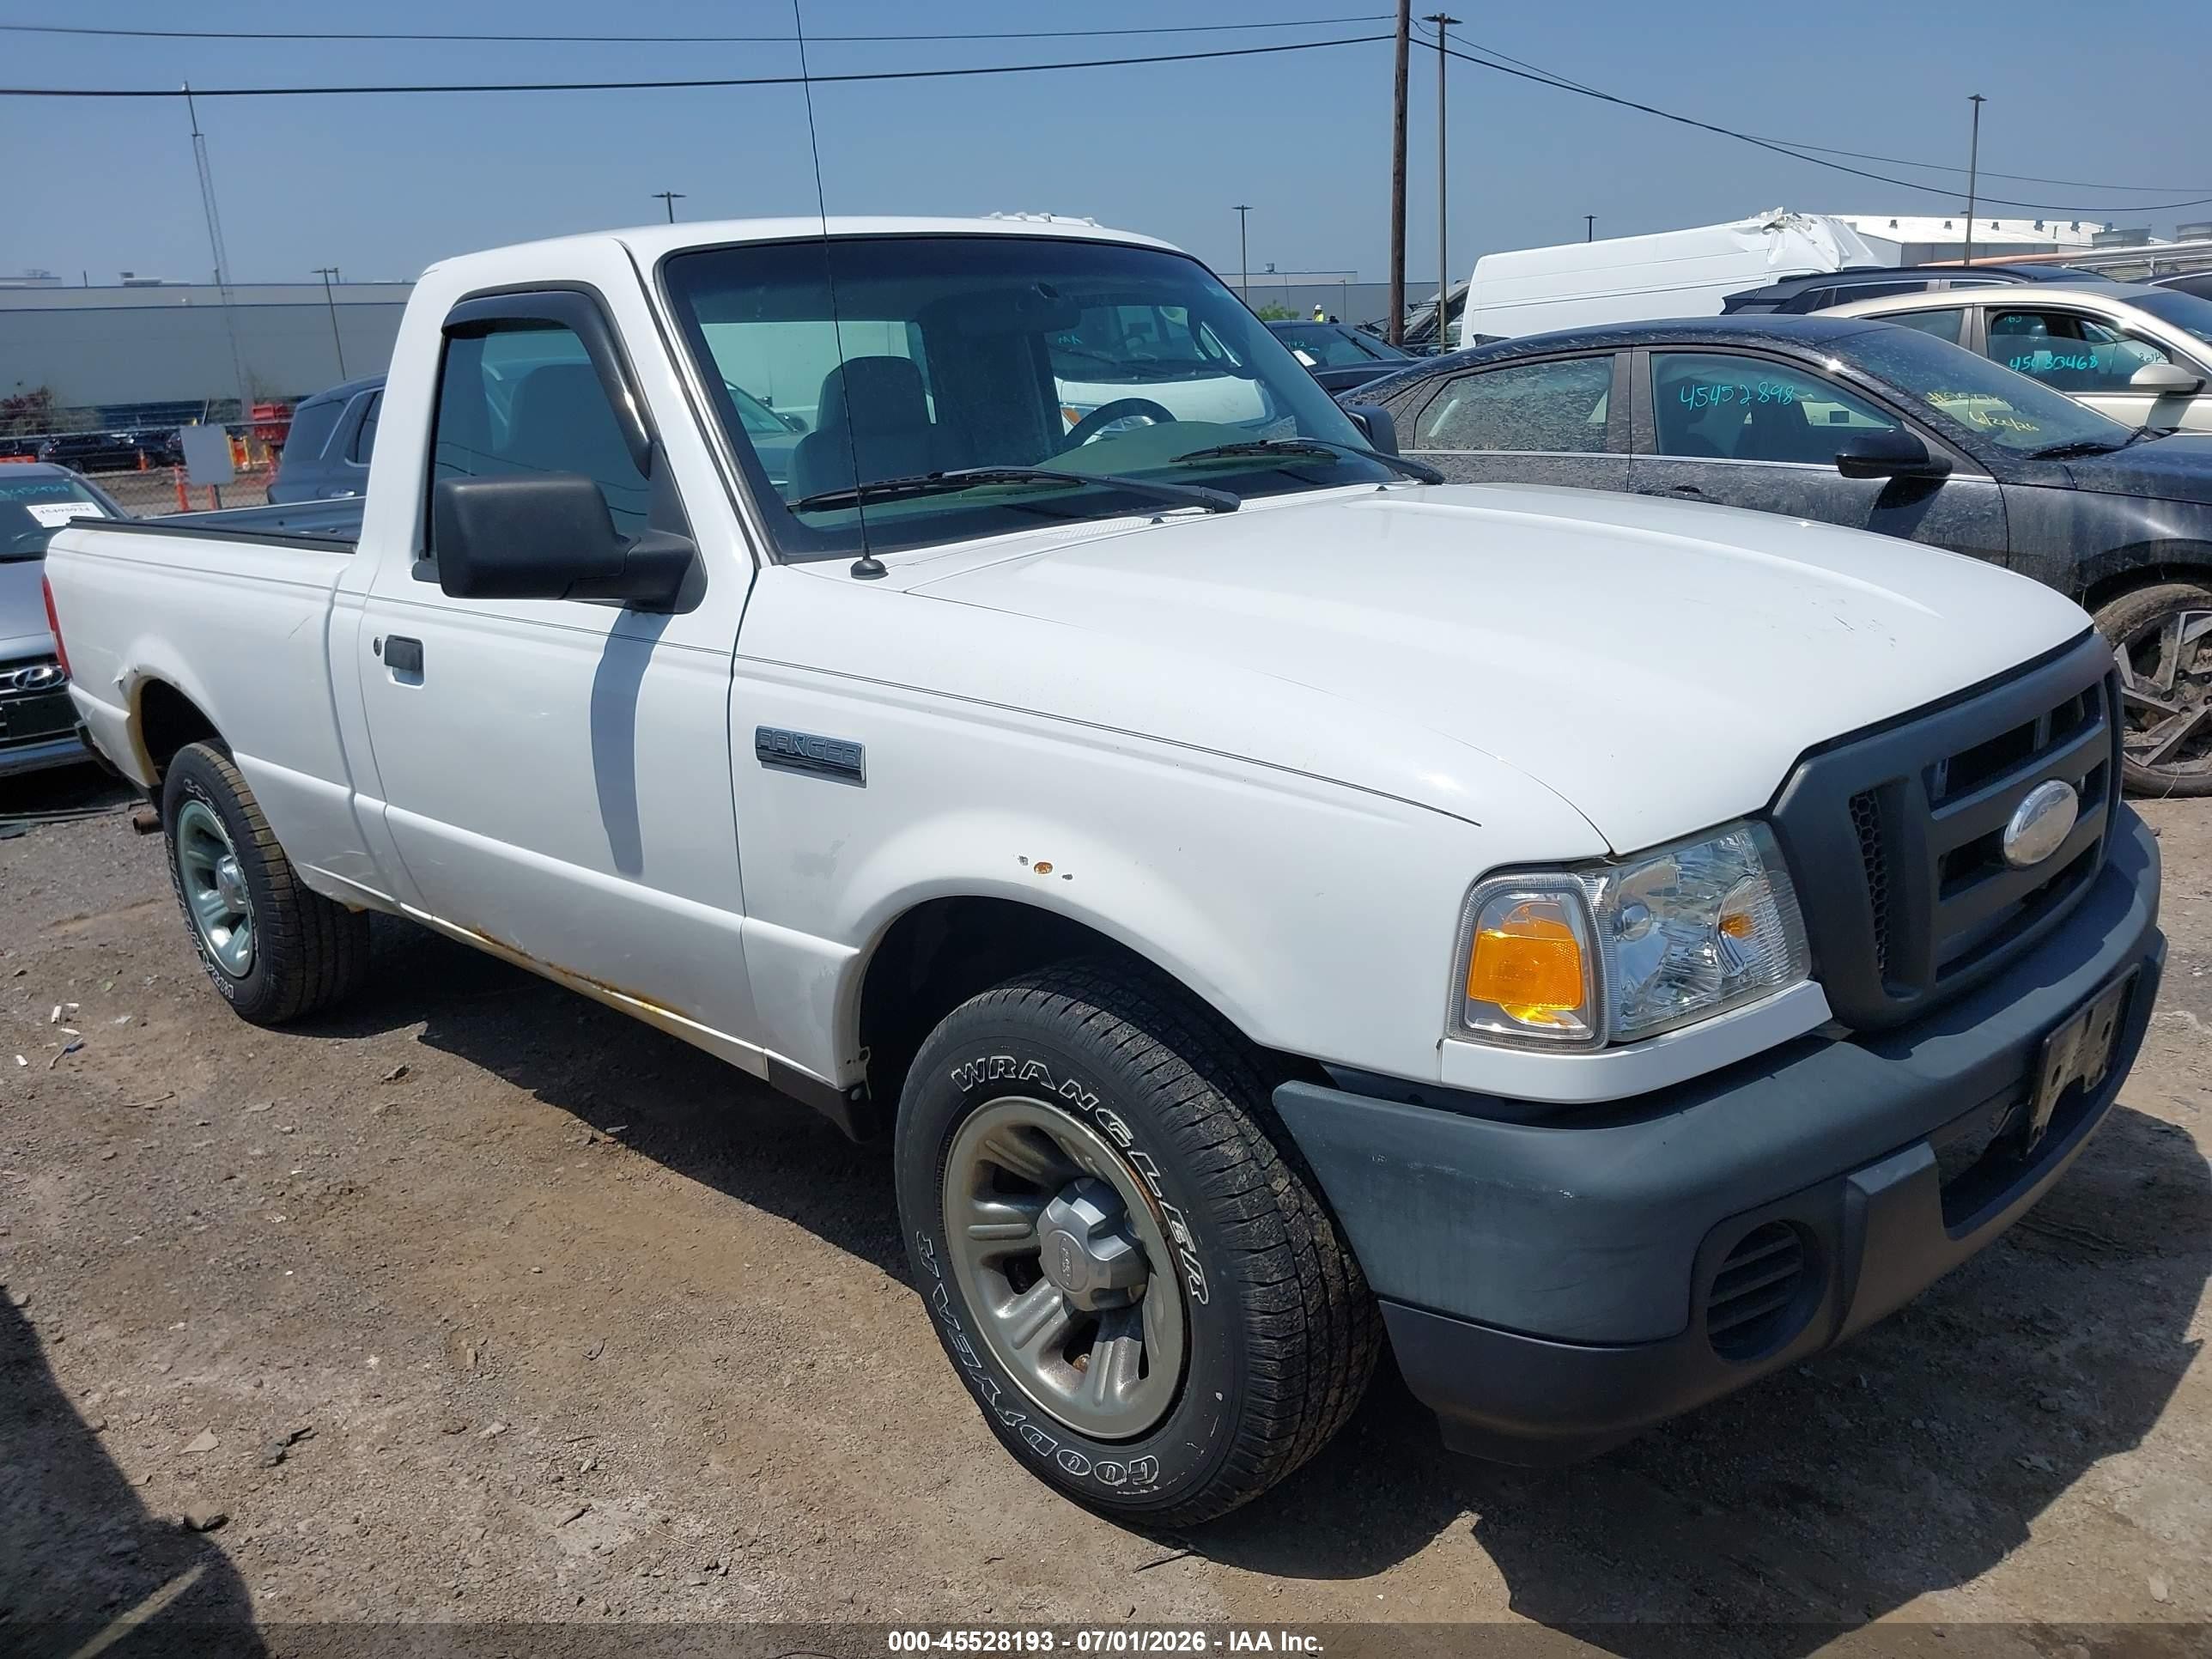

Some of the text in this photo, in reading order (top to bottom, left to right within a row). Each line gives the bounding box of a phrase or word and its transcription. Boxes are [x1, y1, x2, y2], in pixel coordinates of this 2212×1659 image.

[1680, 381, 1795, 410] 45452898
[756, 726, 860, 767] RANGER
[951, 1055, 1209, 1305] WRANGLER
[915, 1231, 1159, 1486] GOODYEAR
